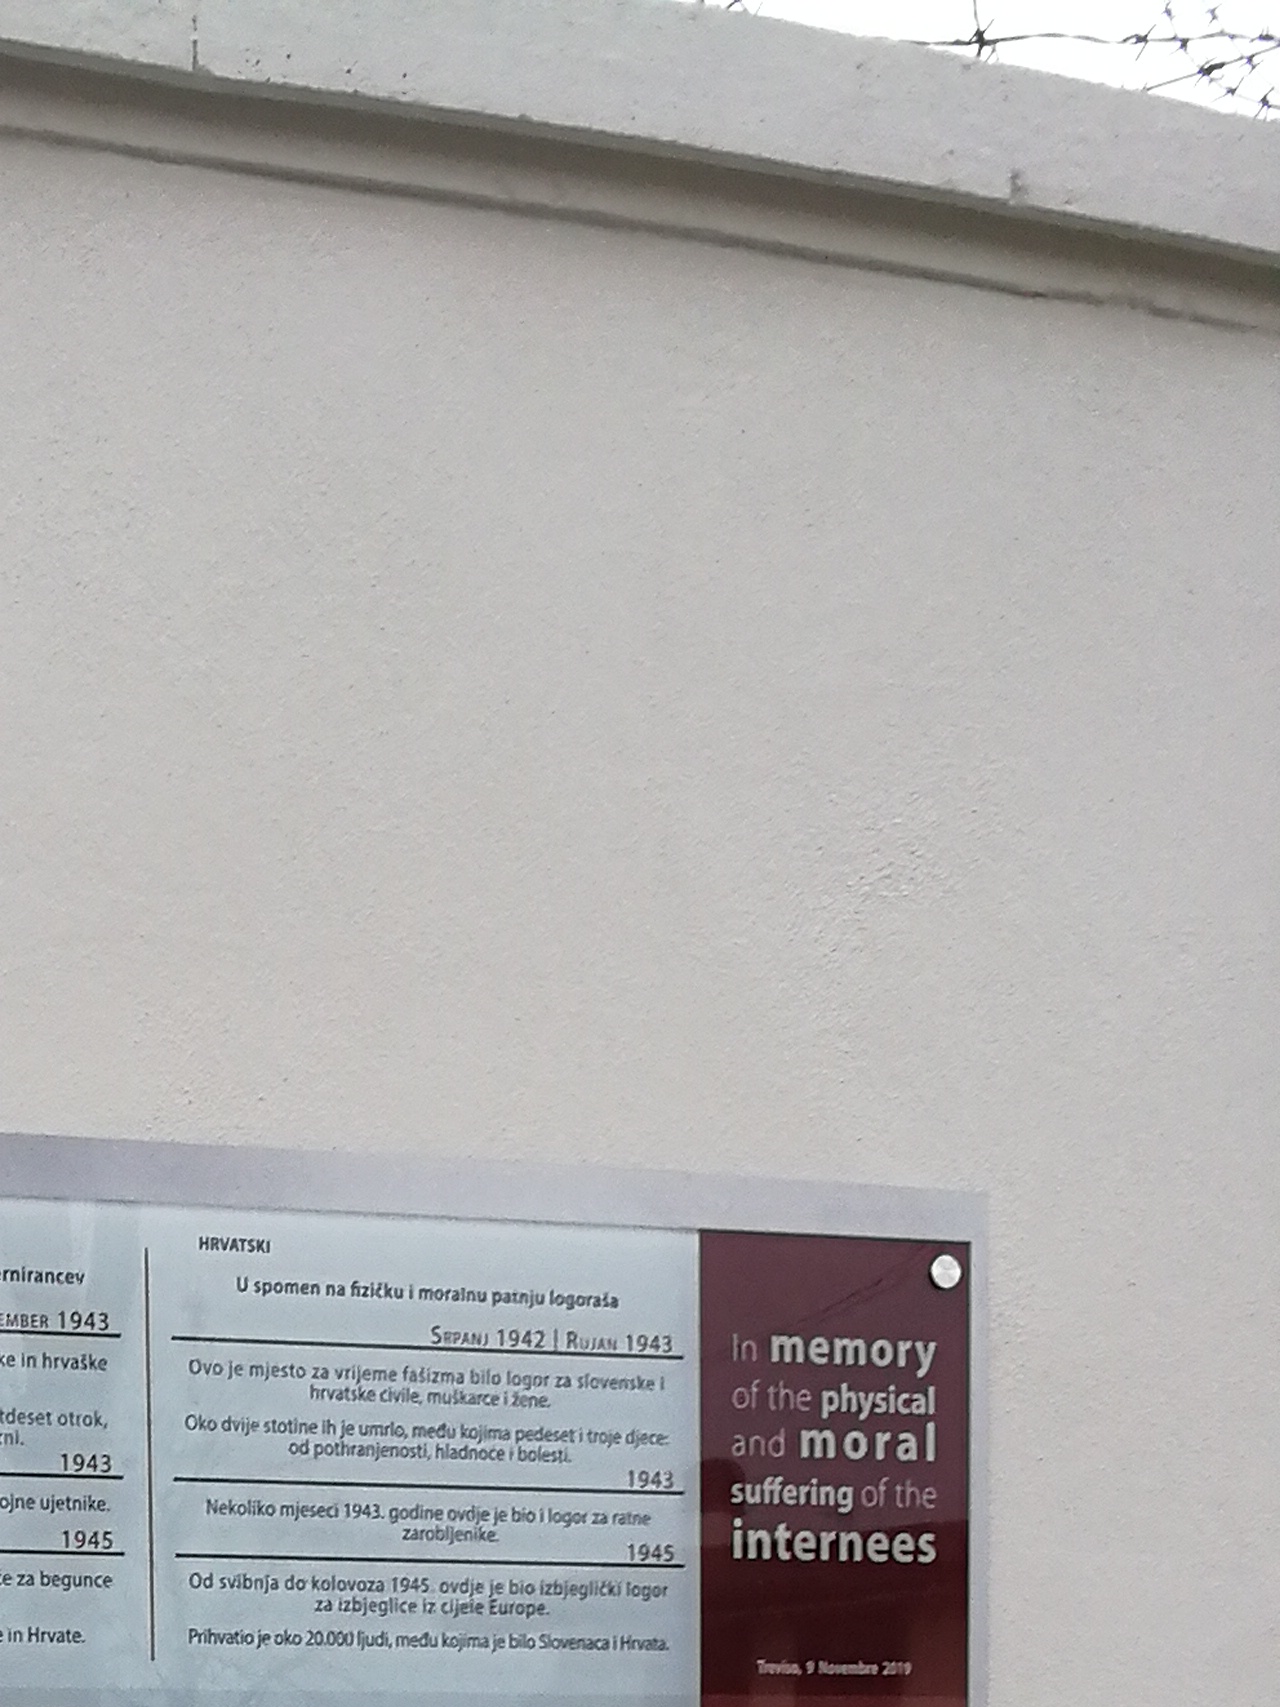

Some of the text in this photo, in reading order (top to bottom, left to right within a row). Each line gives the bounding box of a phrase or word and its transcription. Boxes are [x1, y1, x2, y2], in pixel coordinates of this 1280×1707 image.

[198, 1236, 271, 1254] HRVATSKI
[733, 1333, 937, 1378] In memory
[732, 1379, 936, 1421] of the physical
[731, 1423, 936, 1462] and moral
[730, 1475, 937, 1514] suffering of the
[732, 1518, 938, 1564] internees
